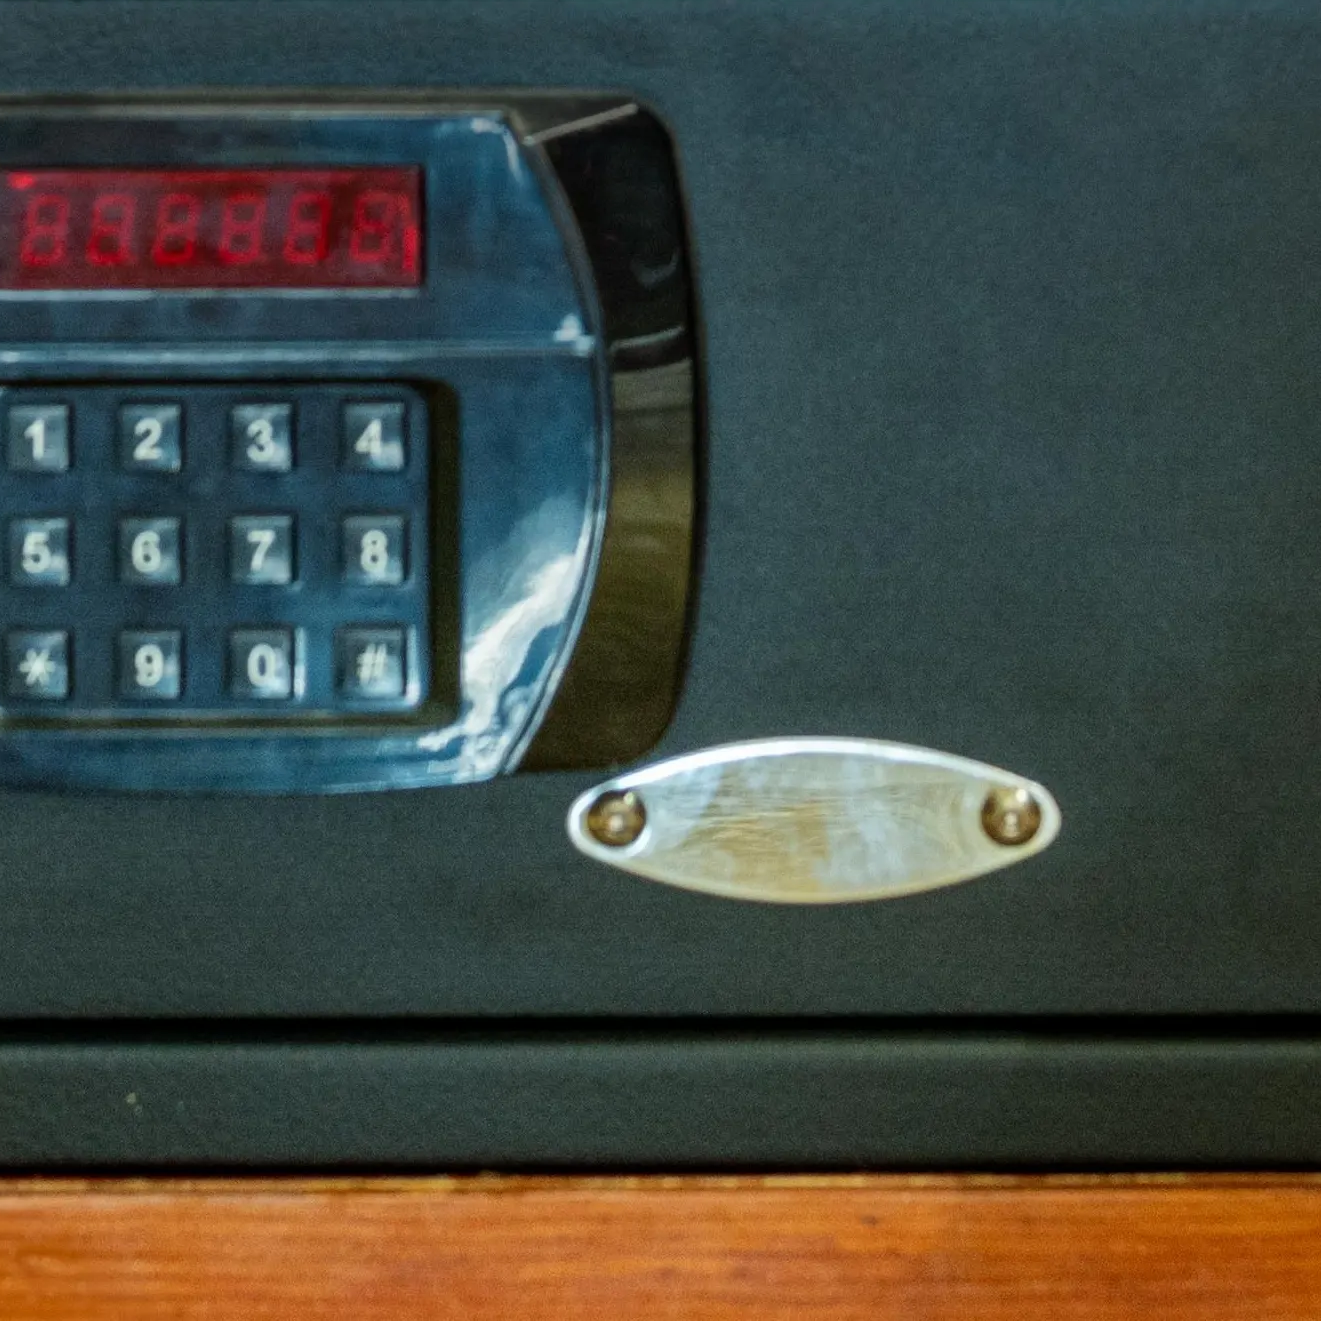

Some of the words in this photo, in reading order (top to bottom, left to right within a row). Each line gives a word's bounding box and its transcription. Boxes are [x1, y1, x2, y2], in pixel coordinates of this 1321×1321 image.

[24, 419, 46, 461] 1
[134, 417, 164, 462] 2
[246, 419, 275, 463] 3
[355, 419, 386, 461] 4
[21, 531, 51, 574] 5
[131, 530, 161, 574] 6
[246, 529, 275, 571] 7
[359, 529, 388, 575] 8
[134, 643, 164, 687] 9
[247, 643, 278, 686] 0
